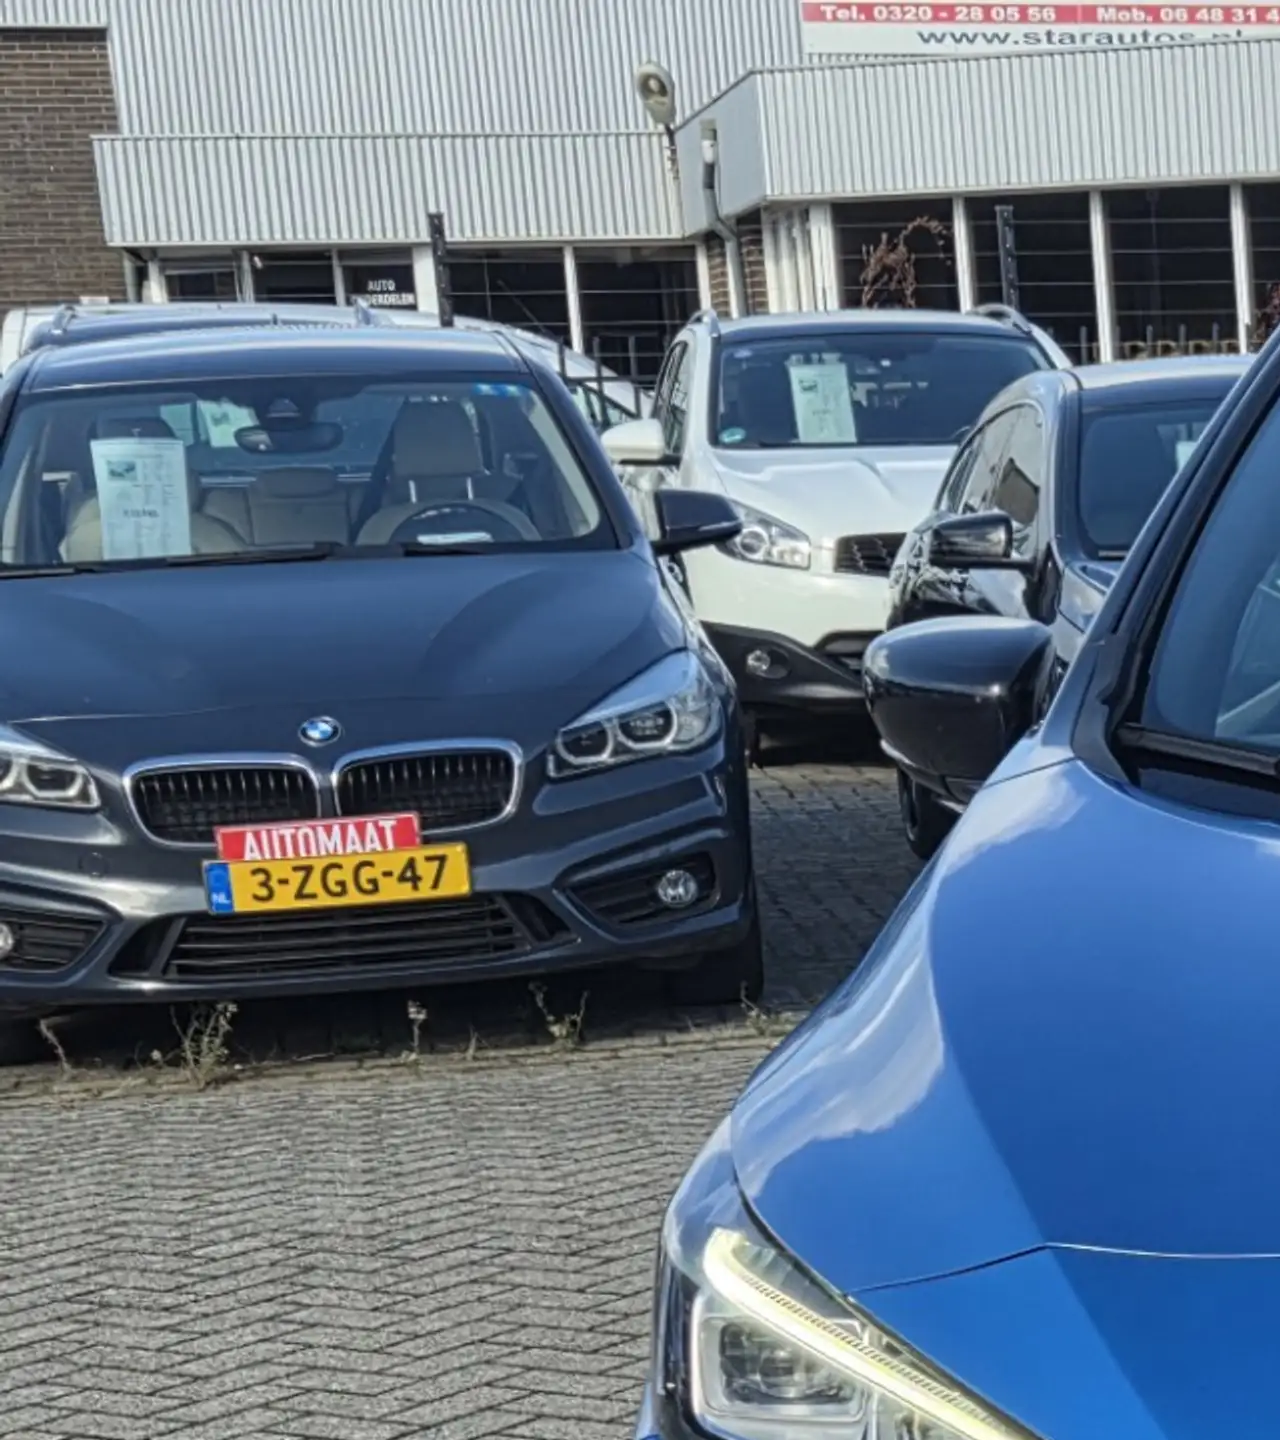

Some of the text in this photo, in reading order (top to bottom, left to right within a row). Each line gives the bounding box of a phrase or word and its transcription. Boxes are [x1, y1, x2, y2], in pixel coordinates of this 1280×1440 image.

[820, 5, 866, 21] Tel.
[873, 6, 932, 21] 0320
[954, 6, 984, 21] 28
[990, 7, 1020, 21] 05
[1027, 7, 1056, 22] 56
[1096, 7, 1152, 22] Mob.
[1159, 7, 1188, 22] 06
[1194, 7, 1224, 22] 48
[1231, 8, 1257, 22] 31
[367, 279, 396, 292] AUTO
[244, 819, 398, 861] AUTOMAAT
[250, 853, 448, 902] 3-ZGG-47
